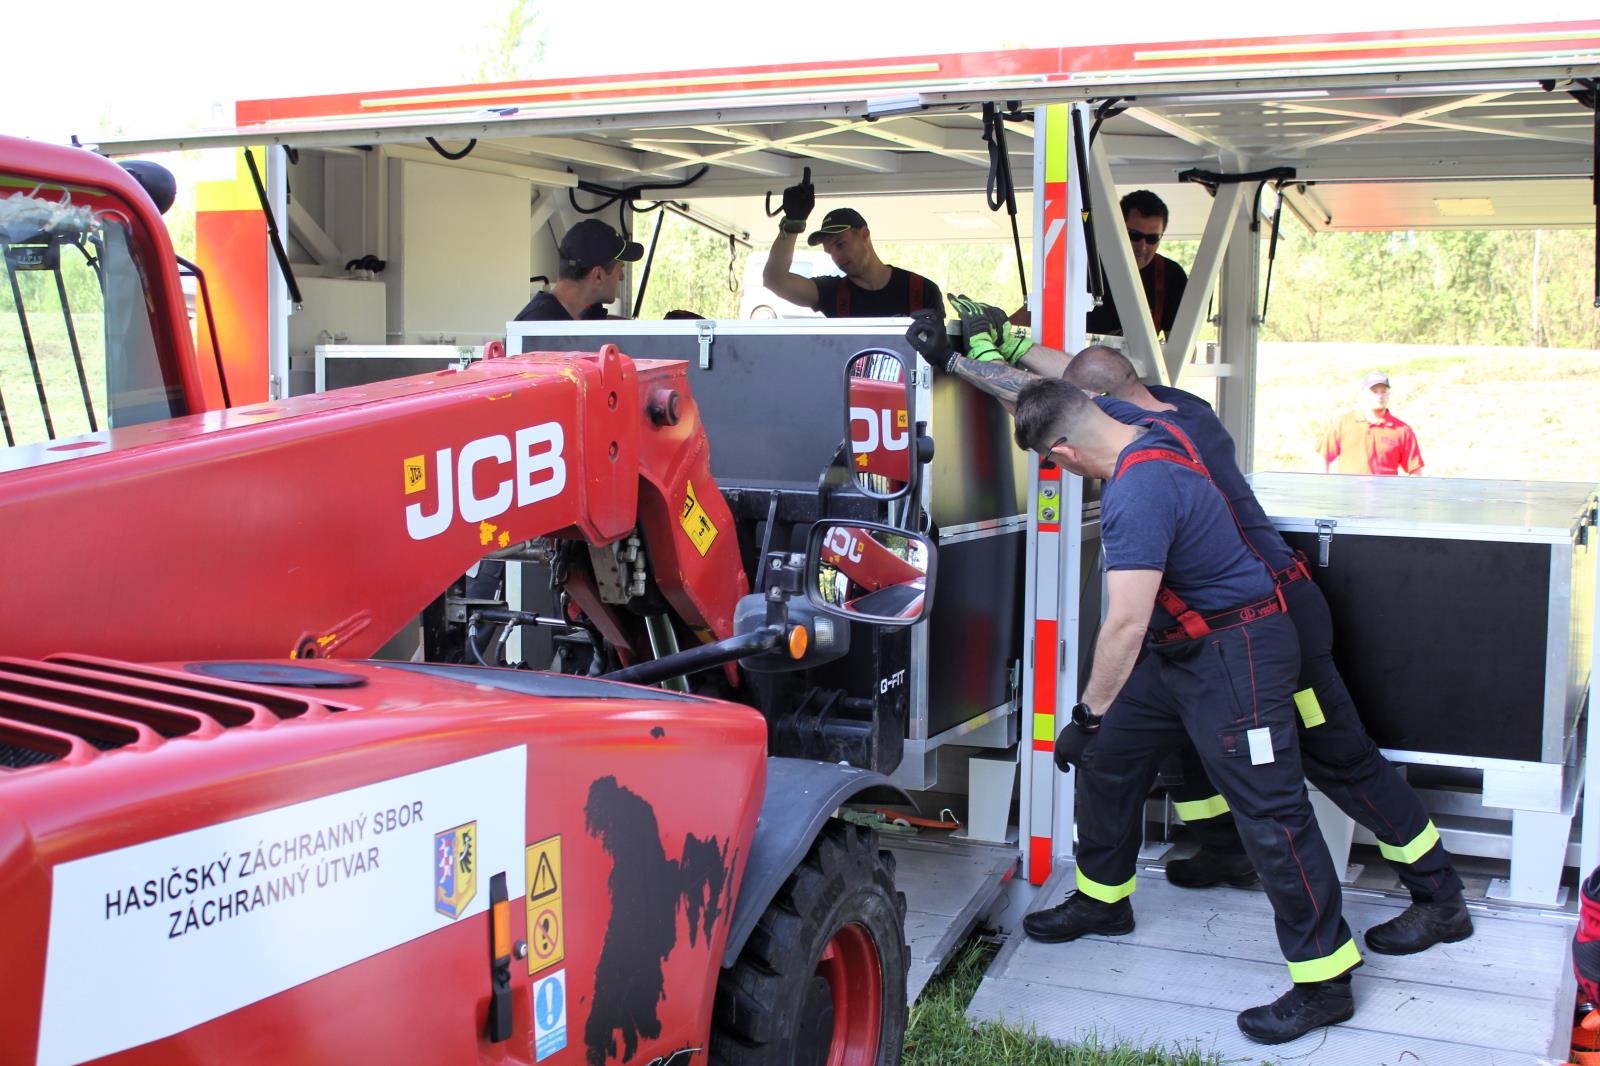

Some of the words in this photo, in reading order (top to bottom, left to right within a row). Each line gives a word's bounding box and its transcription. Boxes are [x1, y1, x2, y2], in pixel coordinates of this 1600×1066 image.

[405, 421, 567, 540] JCB
[409, 466, 422, 484] JCB
[105, 852, 231, 919] HASIČSKÝ
[238, 812, 367, 878] ZÁCHRANNÝ
[373, 800, 424, 835] SBOR
[168, 863, 310, 939] ZÁCHRANNÝ
[316, 846, 380, 888] ÚTVAR
